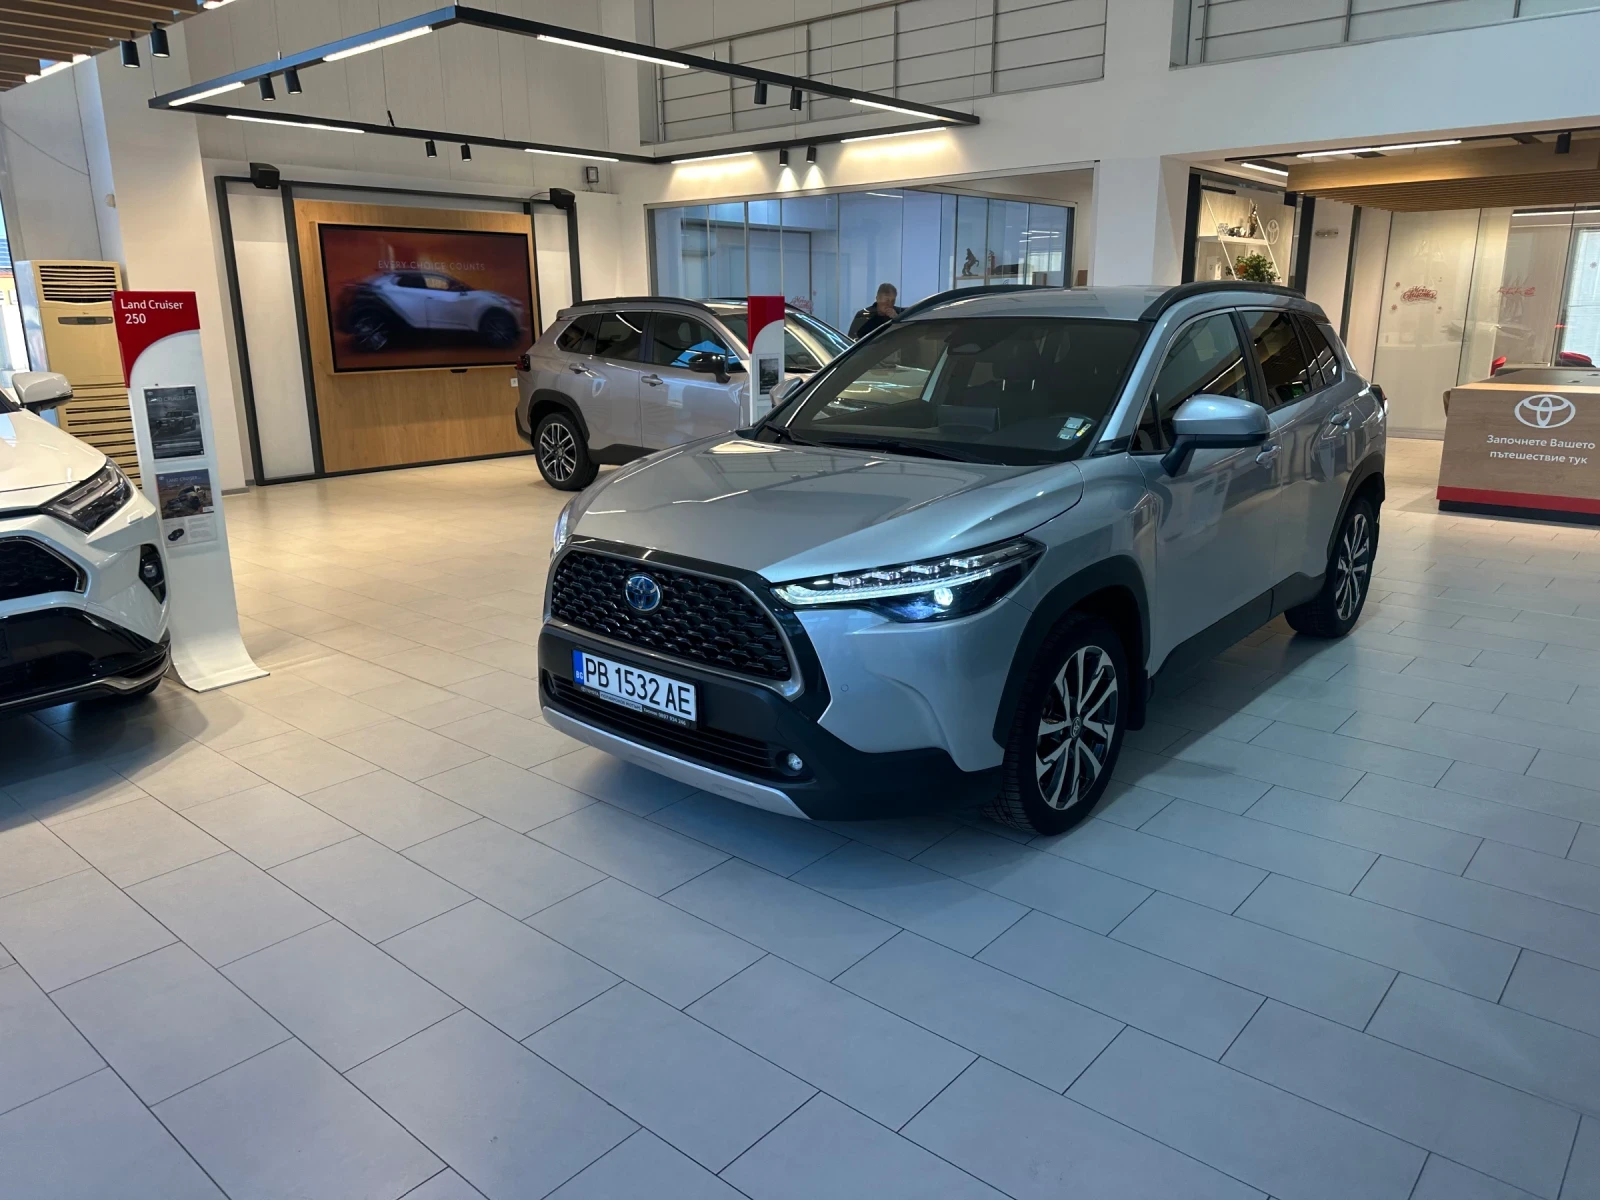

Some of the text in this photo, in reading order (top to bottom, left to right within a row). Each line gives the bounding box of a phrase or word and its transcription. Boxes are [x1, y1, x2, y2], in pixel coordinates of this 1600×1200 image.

[378, 260, 485, 271] EVERY CHOICE COUNTS
[120, 298, 184, 310] Land Cruiser
[125, 313, 147, 325] 250
[1486, 434, 1596, 449] Започнете Вашето
[1489, 450, 1588, 466] пътешествие тук
[575, 670, 584, 680] BG
[615, 667, 661, 706] 1532
